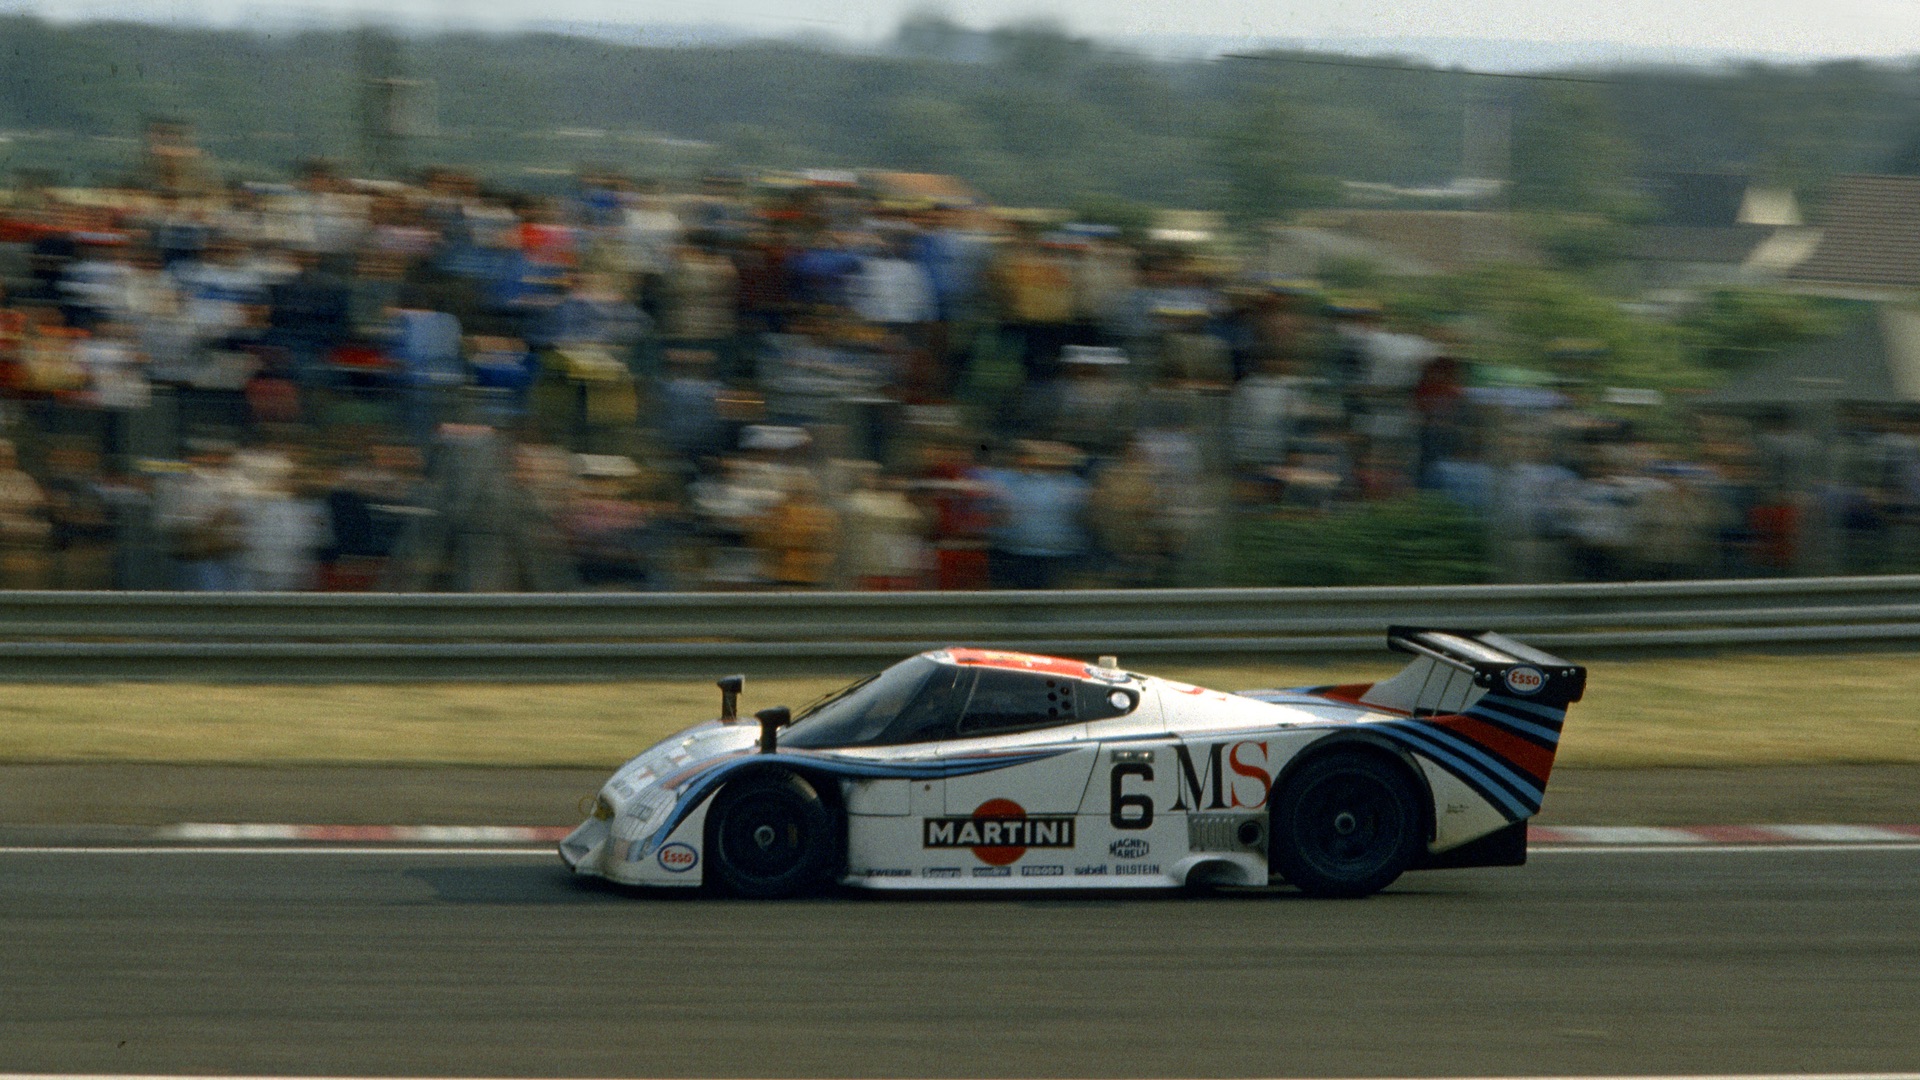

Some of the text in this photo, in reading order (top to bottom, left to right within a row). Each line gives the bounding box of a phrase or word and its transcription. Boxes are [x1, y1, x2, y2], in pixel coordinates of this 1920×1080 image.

[1511, 671, 1540, 686] Esso
[1168, 741, 1272, 811] MS
[1110, 763, 1154, 829] 6
[928, 822, 1071, 844] MARTINI
[664, 850, 692, 863] Esso
[1115, 864, 1160, 875] BILSTEIN
